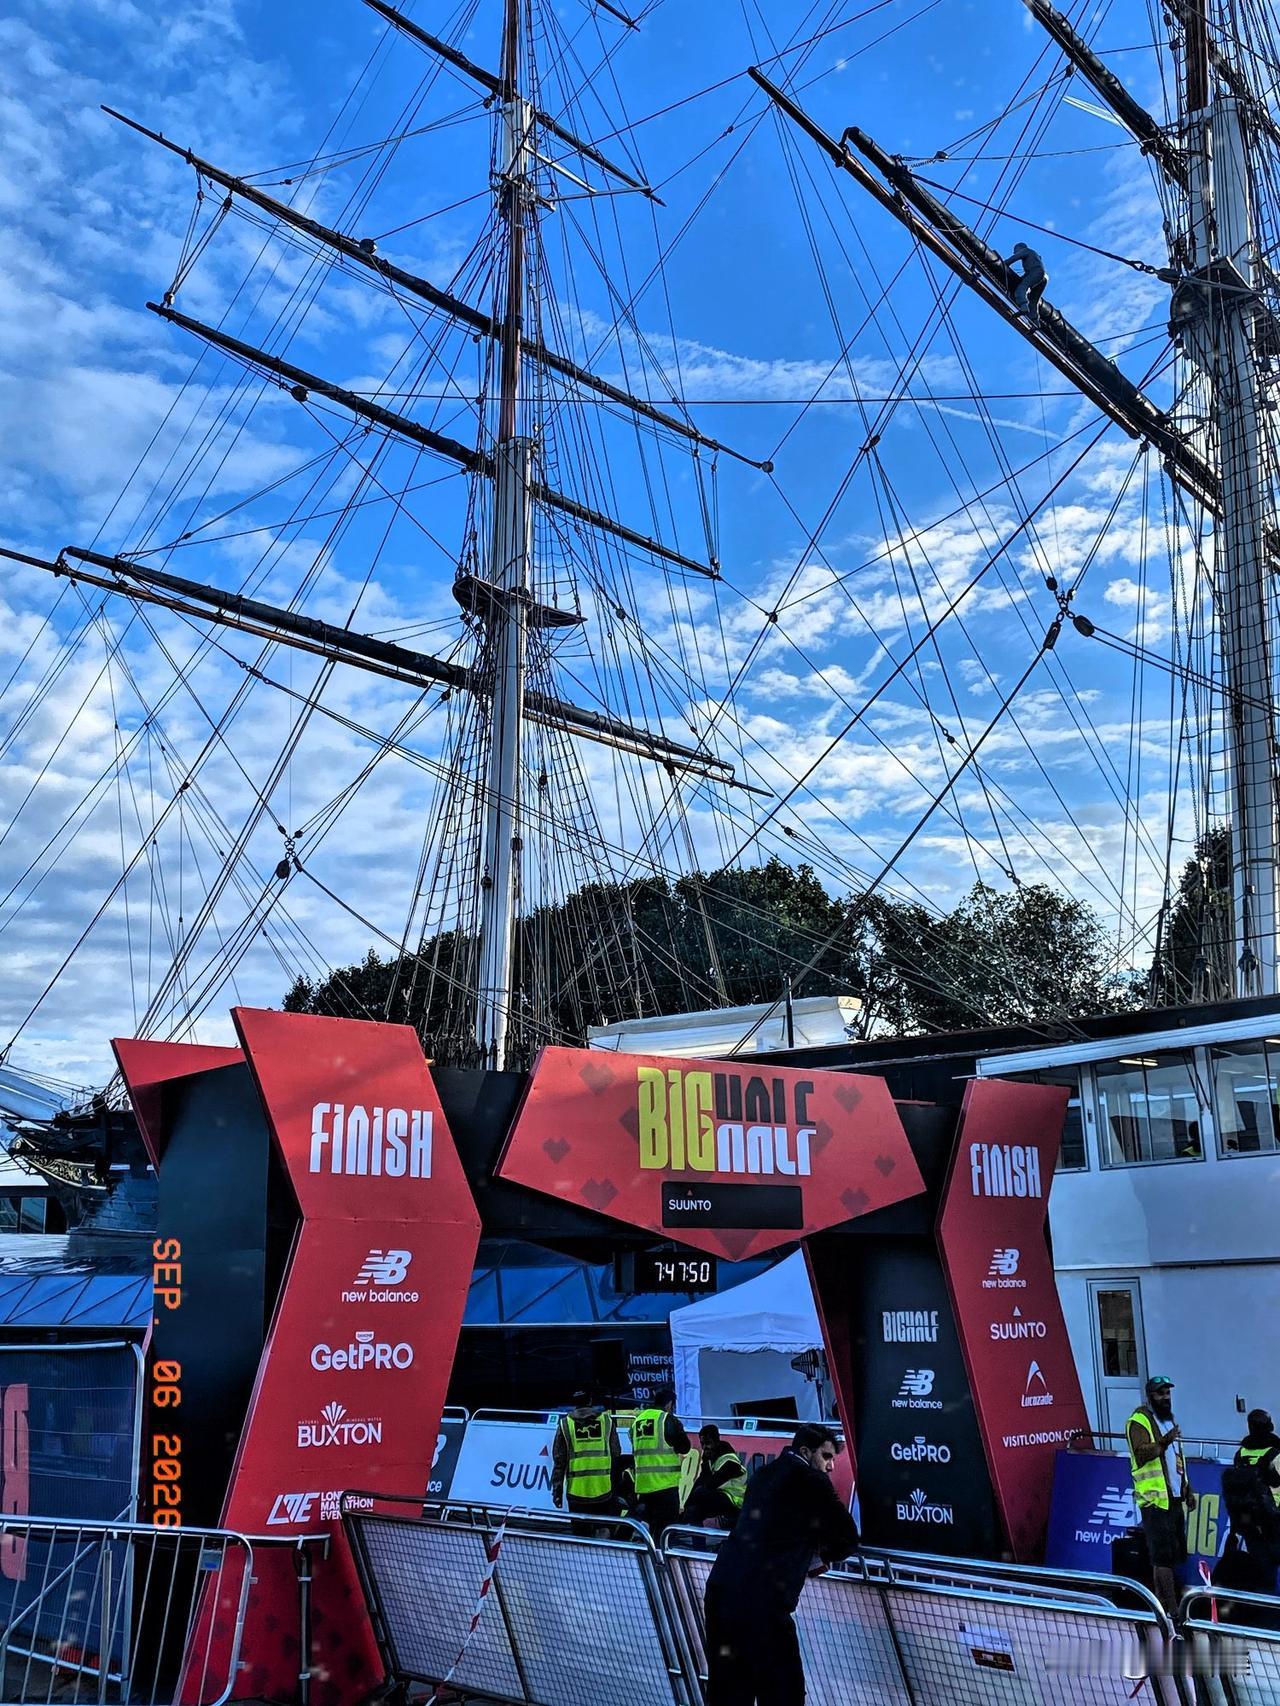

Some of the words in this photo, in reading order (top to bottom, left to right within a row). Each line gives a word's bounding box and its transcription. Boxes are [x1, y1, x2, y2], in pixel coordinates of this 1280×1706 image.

[309, 1102, 433, 1179] FINISH
[970, 1143, 1042, 1198] FINISH
[668, 1199, 712, 1211] SUUNTO
[982, 1279, 997, 1288] new
[997, 1278, 1027, 1288] balance
[341, 1291, 366, 1303] new
[369, 1289, 419, 1303] balance
[990, 1322, 1047, 1340] SUUNTO
[310, 1342, 414, 1371] GetPRO
[629, 1353, 674, 1365] Immerse
[627, 1370, 669, 1385] yourself
[631, 1387, 650, 1399] 150
[1020, 1392, 1054, 1407] Lucozade
[891, 1399, 908, 1409] new
[909, 1398, 942, 1410] balance
[297, 1422, 382, 1448] BUXTON
[891, 1443, 951, 1464] GetPRO
[490, 1461, 551, 1491] SUUN
[320, 1510, 344, 1521] EVEN
[896, 1503, 954, 1525] BUXTON
[1074, 1529, 1101, 1544] new
